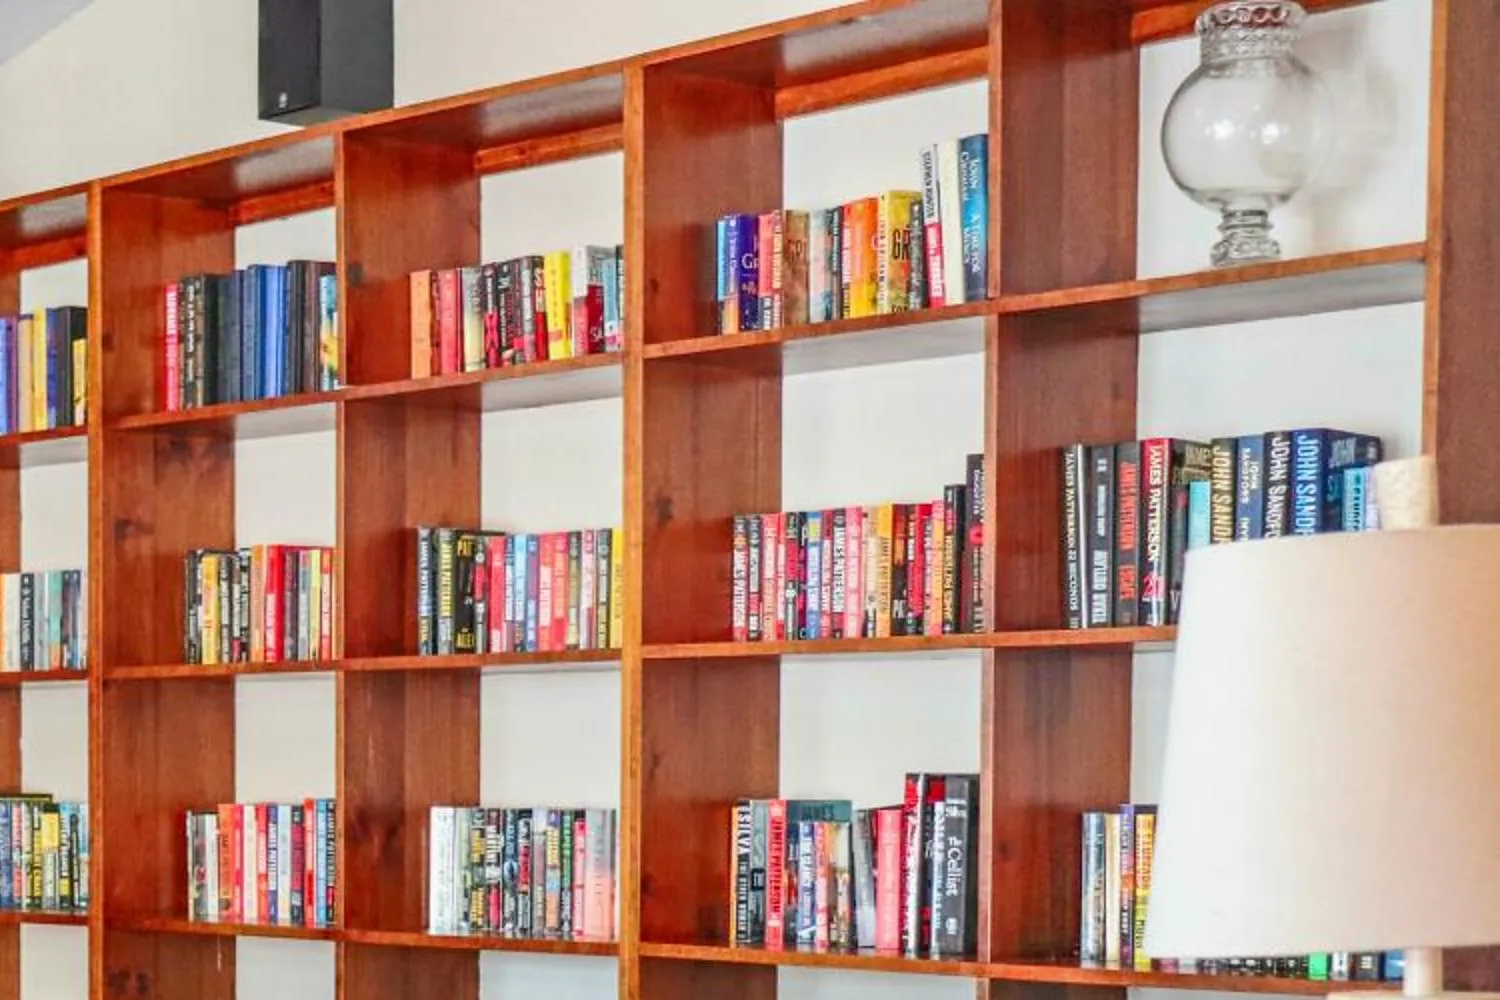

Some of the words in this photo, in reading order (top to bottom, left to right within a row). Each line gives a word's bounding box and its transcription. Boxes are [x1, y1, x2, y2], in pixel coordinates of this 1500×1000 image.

[1148, 445, 1163, 485] JAMES
[1211, 446, 1232, 491] JOHN
[1269, 437, 1290, 481] JOHN
[1294, 435, 1319, 480] JOHN
[1146, 488, 1162, 563] PATTERSON
[1212, 494, 1233, 544] SANDF
[1264, 485, 1288, 539] SANDFO
[1294, 483, 1318, 536] SANDF
